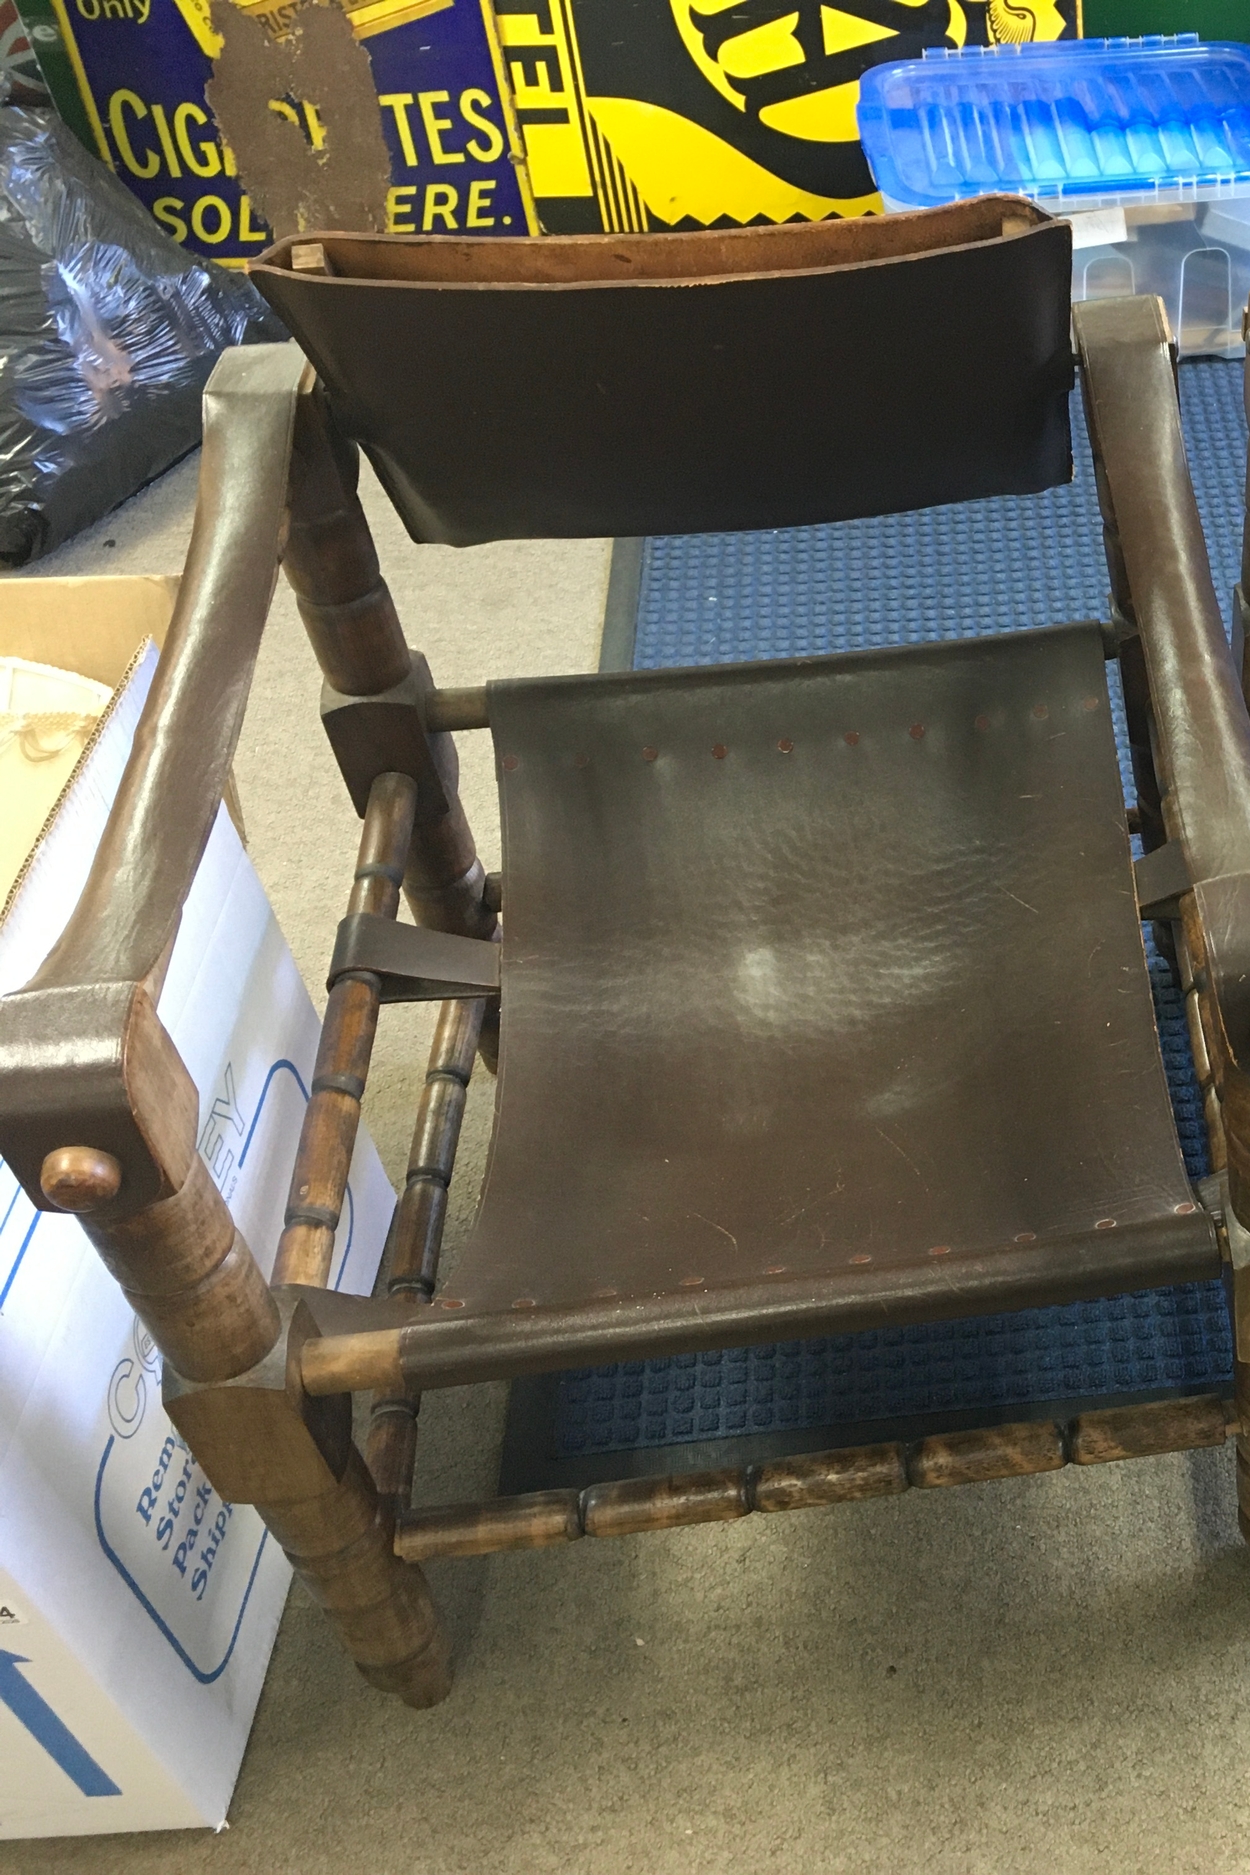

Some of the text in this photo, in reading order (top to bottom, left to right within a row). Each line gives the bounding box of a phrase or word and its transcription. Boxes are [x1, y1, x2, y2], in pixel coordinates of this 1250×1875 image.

[108, 88, 504, 179] CIGTES
[153, 179, 512, 244] SOL ERE.
[136, 1436, 175, 1528] Rem
[156, 1453, 198, 1551] Stor
[172, 1481, 213, 1579] Pack
